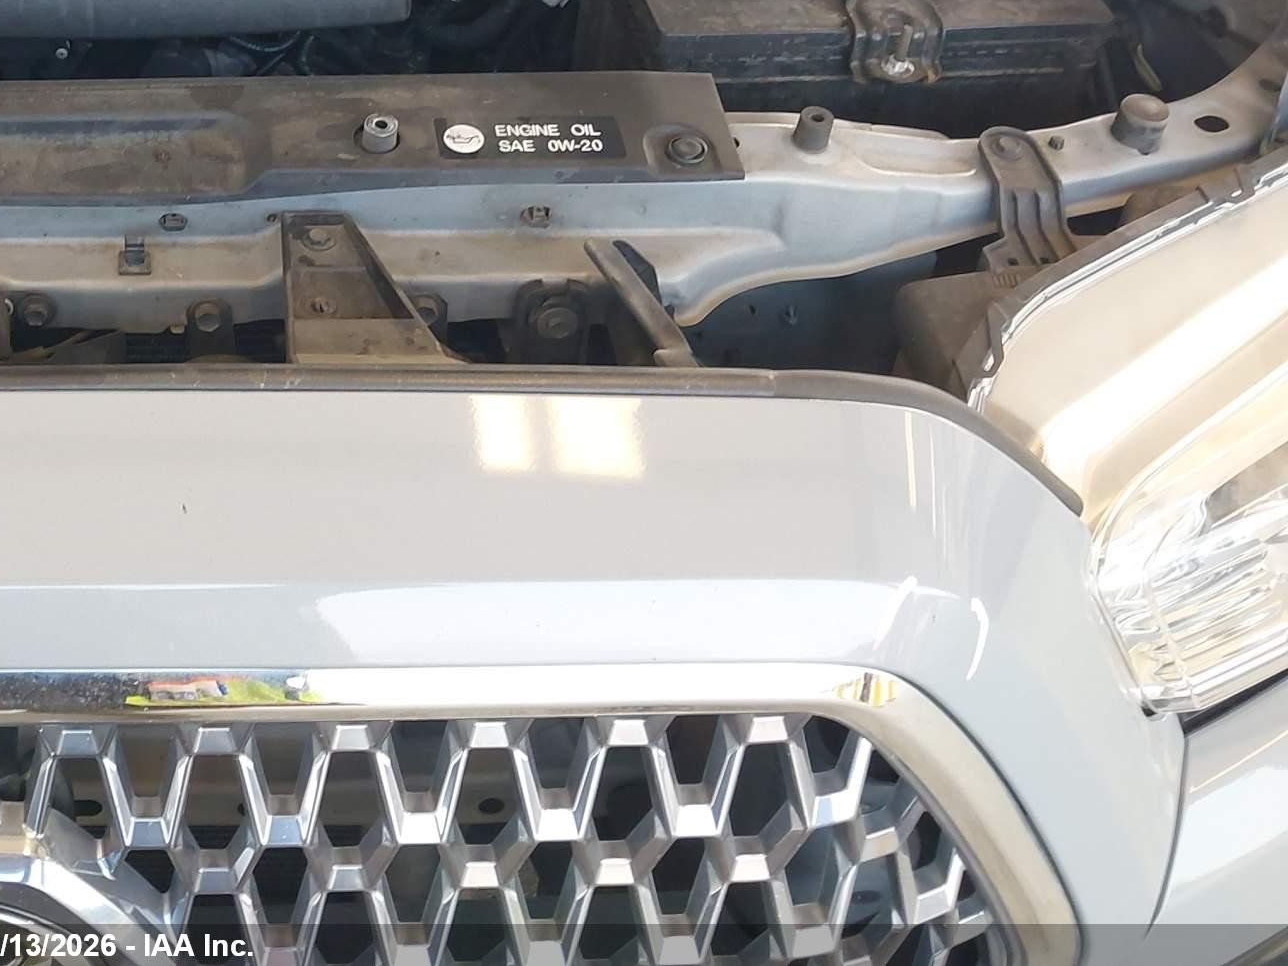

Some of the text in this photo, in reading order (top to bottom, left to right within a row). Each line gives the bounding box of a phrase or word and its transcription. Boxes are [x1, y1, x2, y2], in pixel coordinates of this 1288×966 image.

[494, 123, 602, 137] ENGINE OIL
[498, 138, 604, 153] SAE 0W-20
